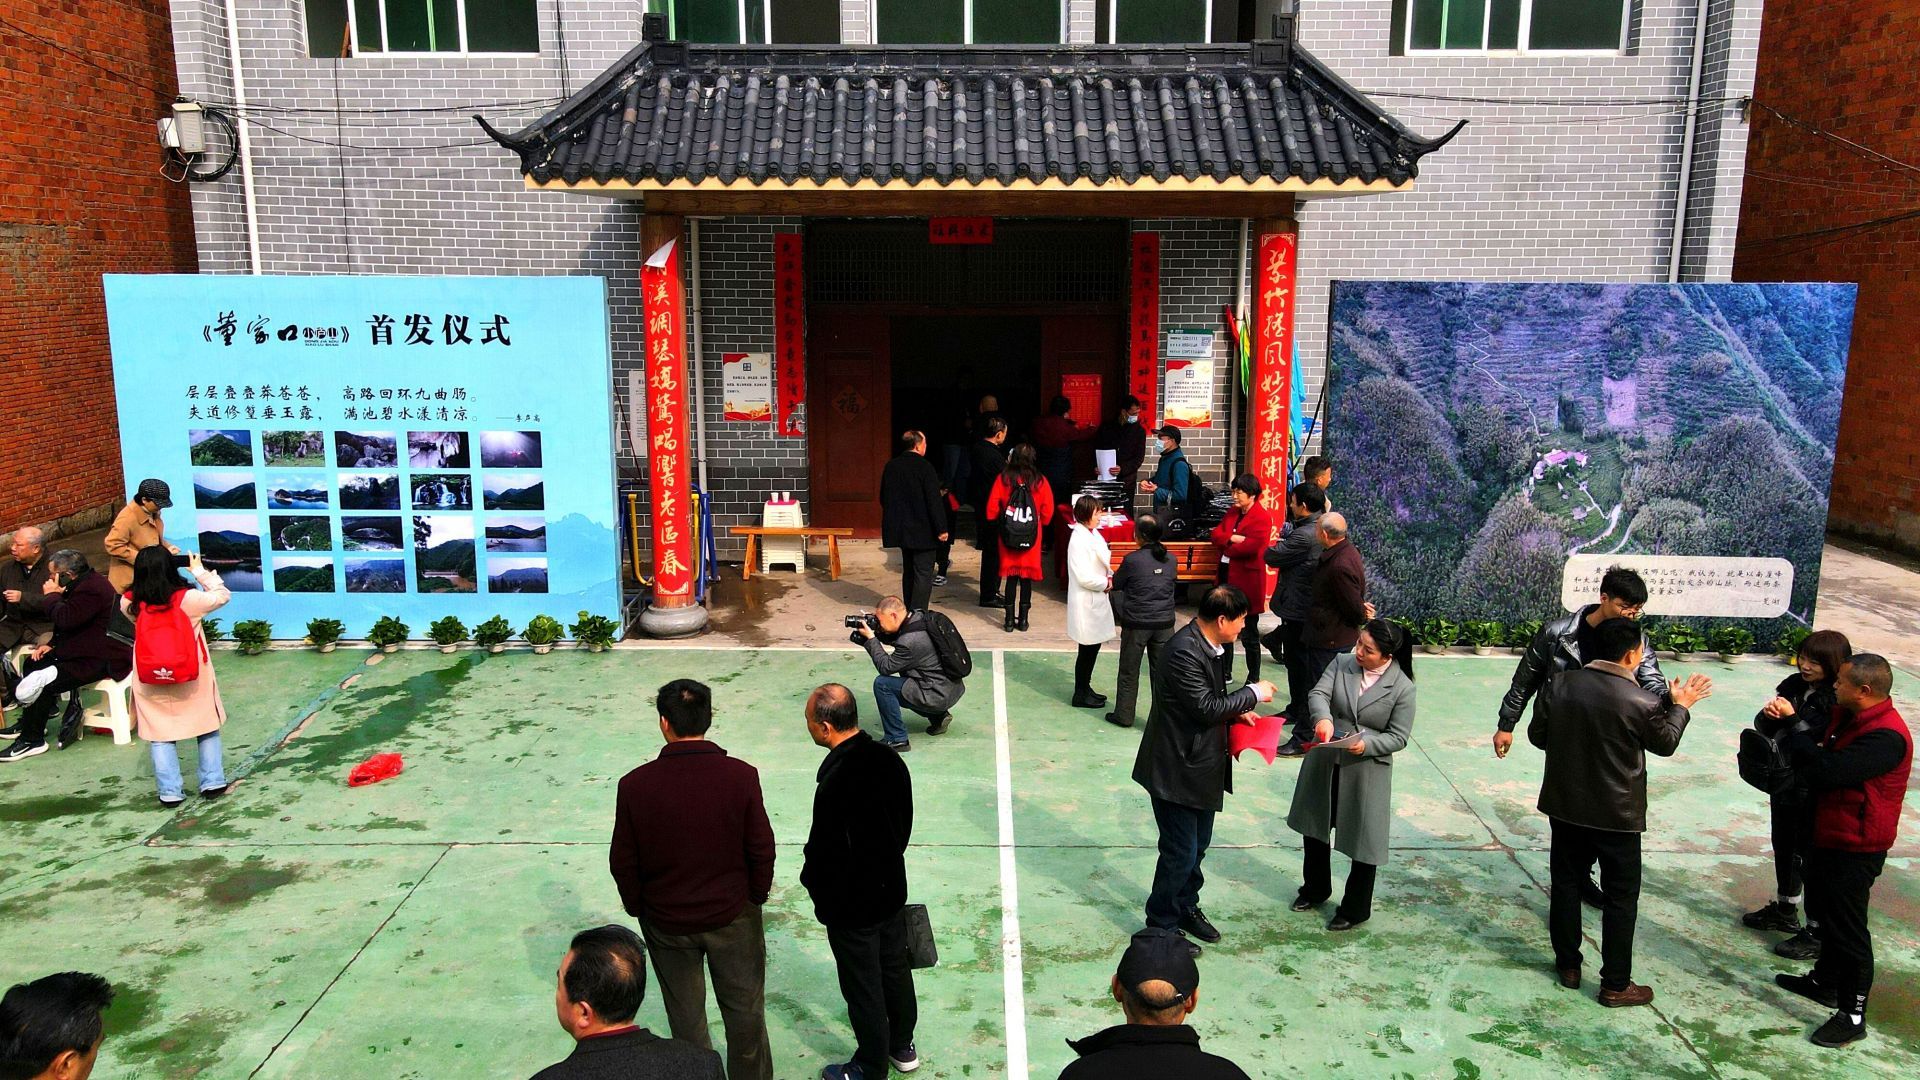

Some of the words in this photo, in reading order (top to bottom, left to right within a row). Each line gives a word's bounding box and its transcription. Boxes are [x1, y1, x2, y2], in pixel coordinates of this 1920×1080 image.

[365, 313, 512, 346] 首发仪式
[185, 384, 321, 402] 层层叠叠莽苍苍，
[342, 385, 477, 403] 高路回环九曲肠。
[344, 405, 478, 423] 满池碧水漾清凉。
